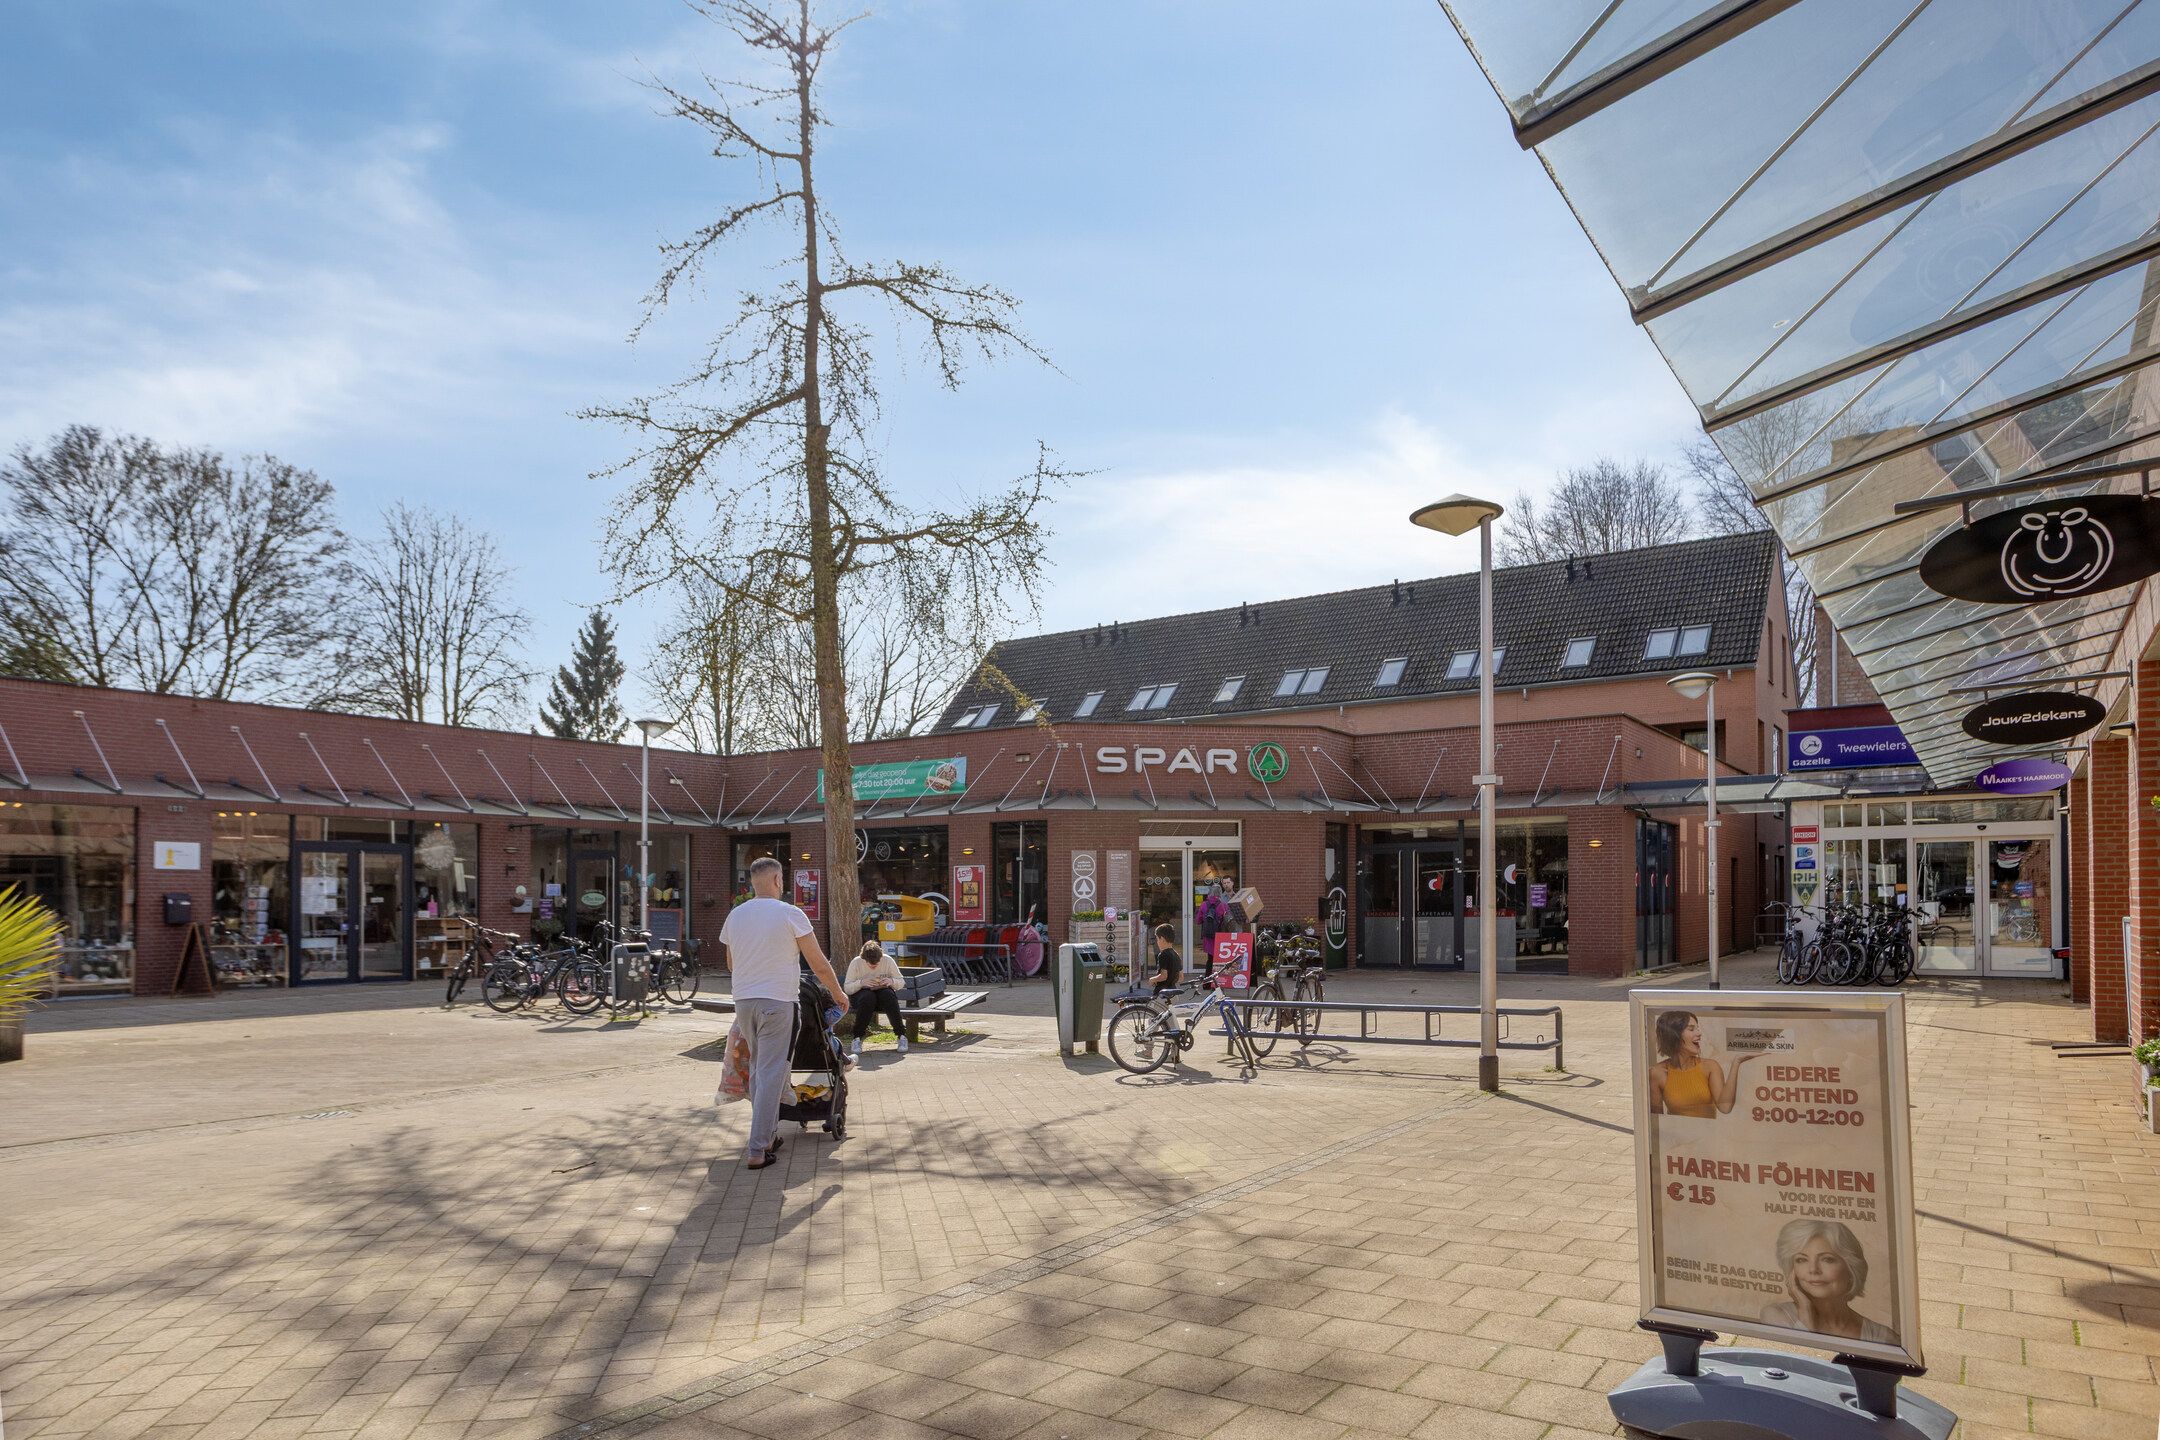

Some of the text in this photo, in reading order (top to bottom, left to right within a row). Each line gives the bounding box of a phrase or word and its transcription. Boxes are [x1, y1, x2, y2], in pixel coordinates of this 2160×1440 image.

[1982, 709, 2087, 727] Jouw2dekans
[1838, 741, 1907, 754] Tweewielers
[1096, 746, 1238, 774] SPAR
[1792, 757, 1831, 767] Gazelle
[884, 778, 904, 786] 20:00
[2023, 773, 2065, 782] HAARMODE
[1793, 873, 1818, 882] RIH
[1219, 942, 1247, 958] 5.75
[1766, 1065, 1841, 1083] IEDERE
[1755, 1086, 1859, 1105] OCHTEND
[1752, 1106, 1865, 1127] 9:00-12:00
[1666, 1155, 1876, 1193] HAREN FÖHNEN
[1688, 1184, 1716, 1206] 15
[1779, 1191, 1876, 1209] VOOR KORT EN
[1764, 1203, 1877, 1222] HALF LANG HAAR
[1666, 1256, 1785, 1282] BEGIN JE DAG GOED
[1666, 1269, 1702, 1283] BEGIN
[1721, 1279, 1783, 1295] GESTYLED
